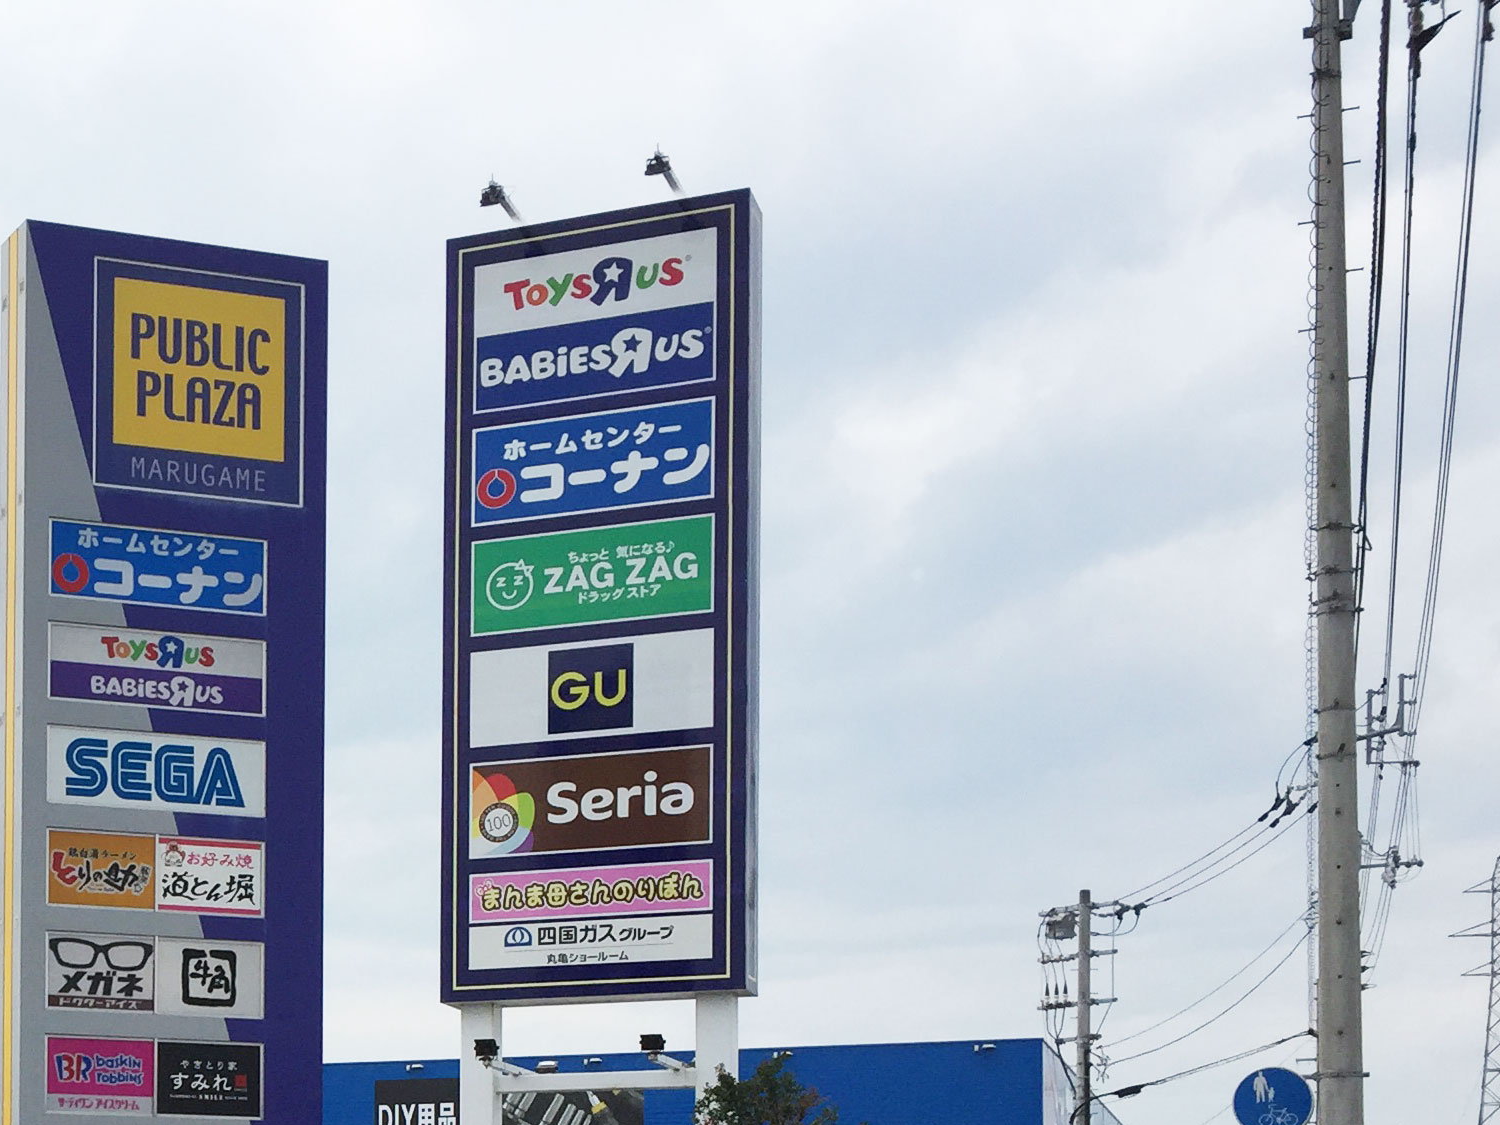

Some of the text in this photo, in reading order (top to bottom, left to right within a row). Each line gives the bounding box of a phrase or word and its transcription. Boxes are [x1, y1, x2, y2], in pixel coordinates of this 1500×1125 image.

[130, 313, 271, 375] PUBLIC
[136, 370, 262, 430] PLAZA
[503, 421, 682, 461] ホームセンター
[131, 457, 266, 492] MARUGAME
[520, 443, 710, 503] コーナン
[78, 527, 239, 560] ホームセンター
[568, 548, 610, 564] ちょっと
[94, 557, 262, 607] コーナン
[544, 552, 699, 594] ZAG ZAG
[551, 669, 627, 710] GU
[65, 738, 245, 808] SEGA
[546, 770, 695, 825] Seria
[487, 813, 511, 831] 100
[187, 852, 254, 869] お好み焼
[161, 871, 256, 905] 道とん堀
[537, 924, 675, 946] 四国ガスグループ
[546, 951, 629, 965] 丸亀ショールーム
[58, 970, 143, 996] メガネ
[55, 1054, 92, 1081] BR
[95, 1054, 141, 1069] baskin
[170, 1072, 232, 1092] すみれ
